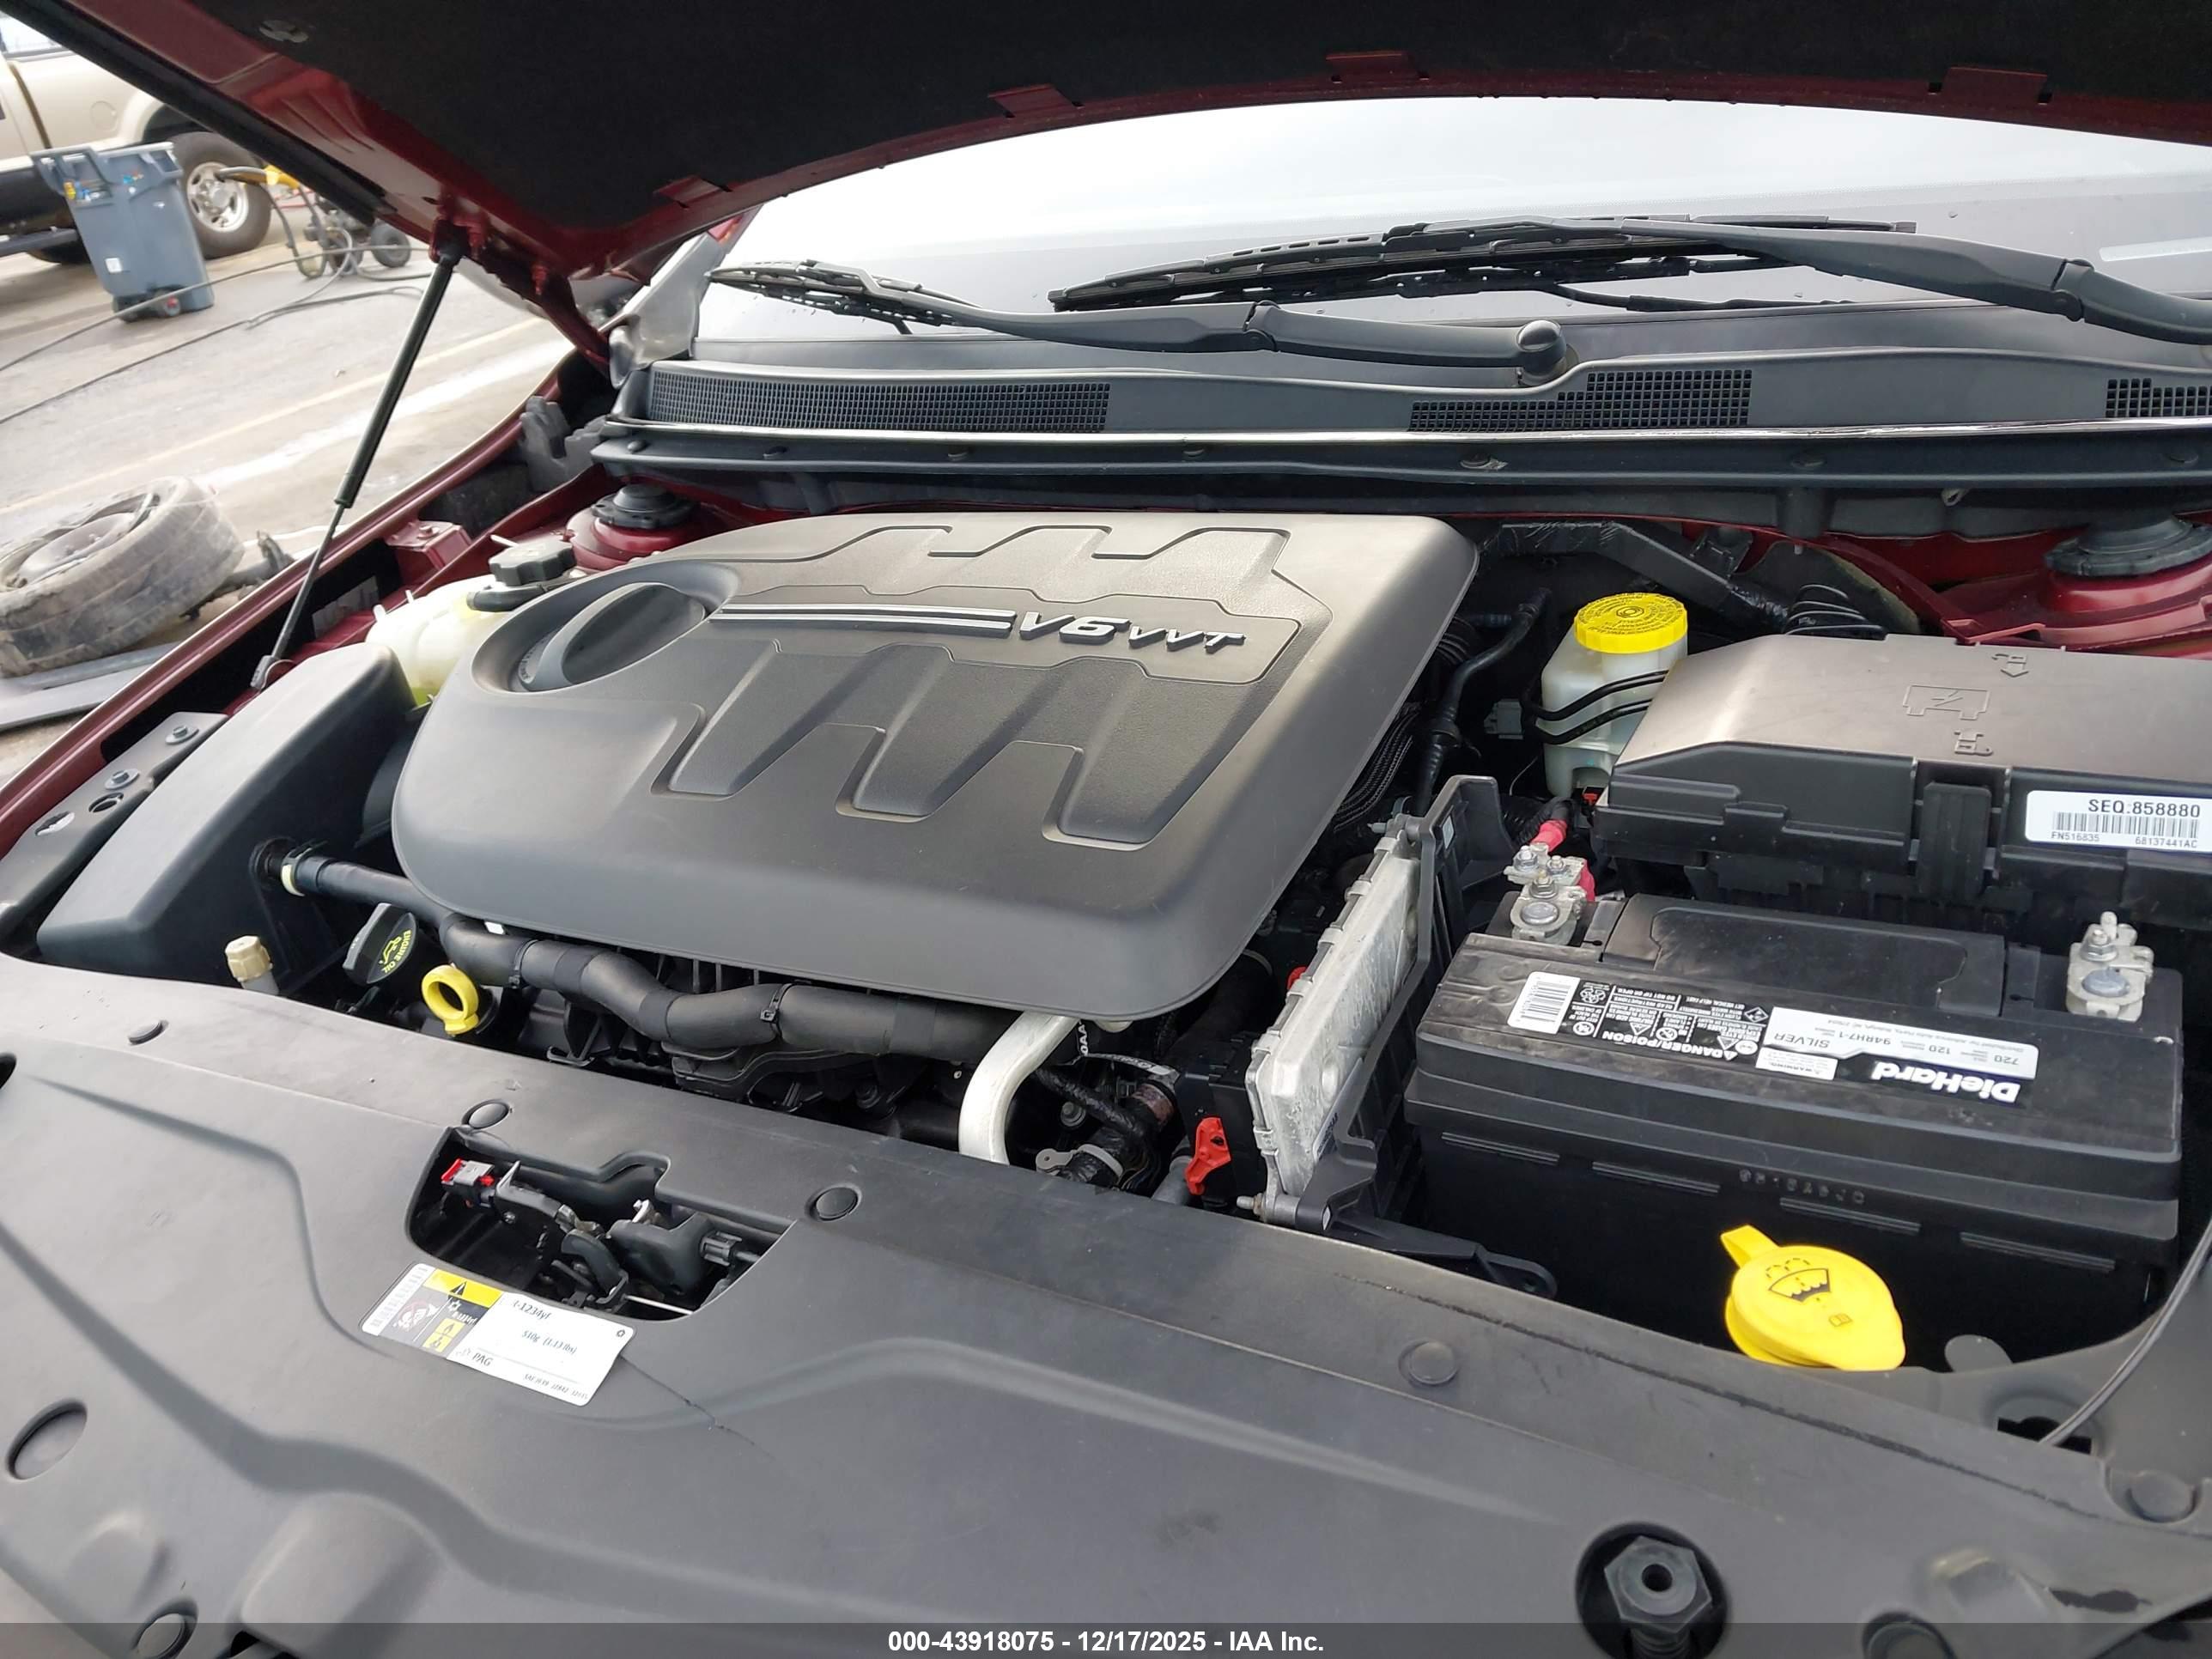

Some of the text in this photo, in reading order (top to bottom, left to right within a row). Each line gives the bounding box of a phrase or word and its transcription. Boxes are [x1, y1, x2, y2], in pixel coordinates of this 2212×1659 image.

[1019, 611, 1247, 653] V6 VVT
[2051, 830, 2198, 848] FN516835 68137441AC
[381, 929, 412, 973] ENGINE OIL
[1601, 1030, 1723, 1058] DANGER/POISON
[1773, 1031, 1830, 1048] SILVER
[1838, 1030, 1891, 1045] 94RH7-1
[1928, 1044, 1950, 1054] 120
[1993, 1054, 2018, 1065] 720
[1873, 1060, 2020, 1103] DieHard
[471, 1352, 495, 1367] PAG
